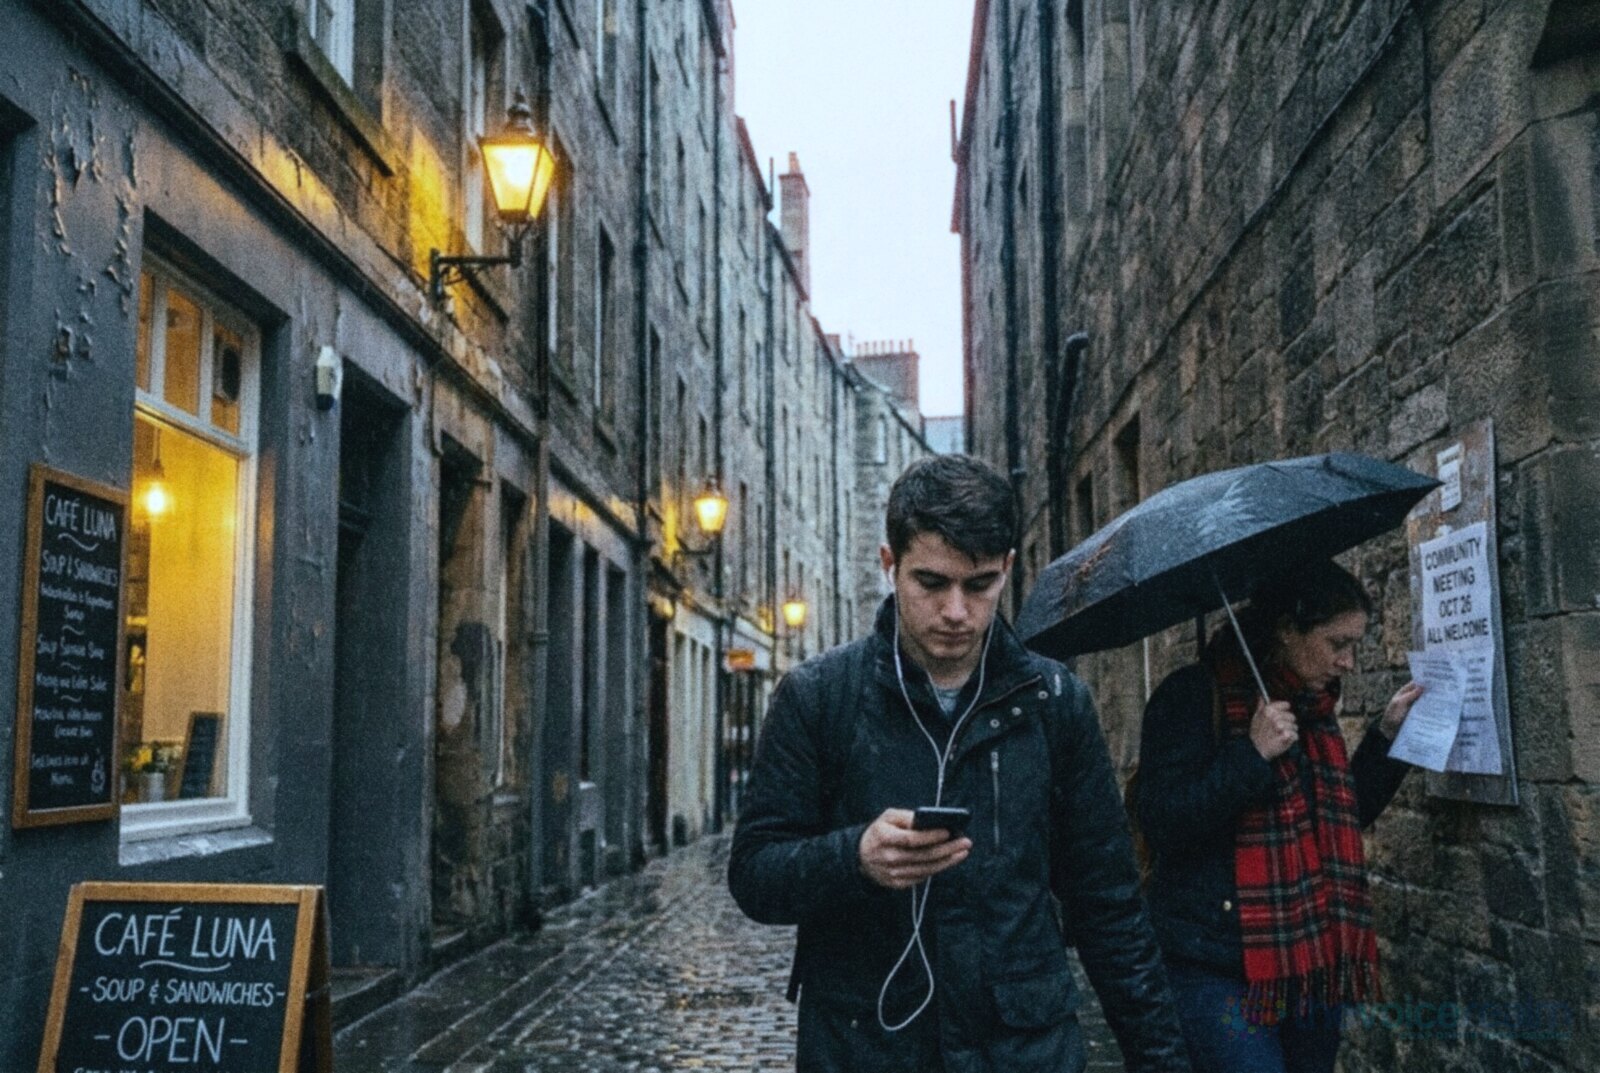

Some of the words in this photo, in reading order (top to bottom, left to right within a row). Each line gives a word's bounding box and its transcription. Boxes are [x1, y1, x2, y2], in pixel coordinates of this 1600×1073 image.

[45, 494, 81, 532] CAFÉ
[82, 507, 117, 542] LUNA
[1438, 597, 1458, 618] OCT
[1426, 627, 1443, 644] ALL
[94, 907, 183, 957] CAFÉ
[191, 914, 276, 961] LUNA
